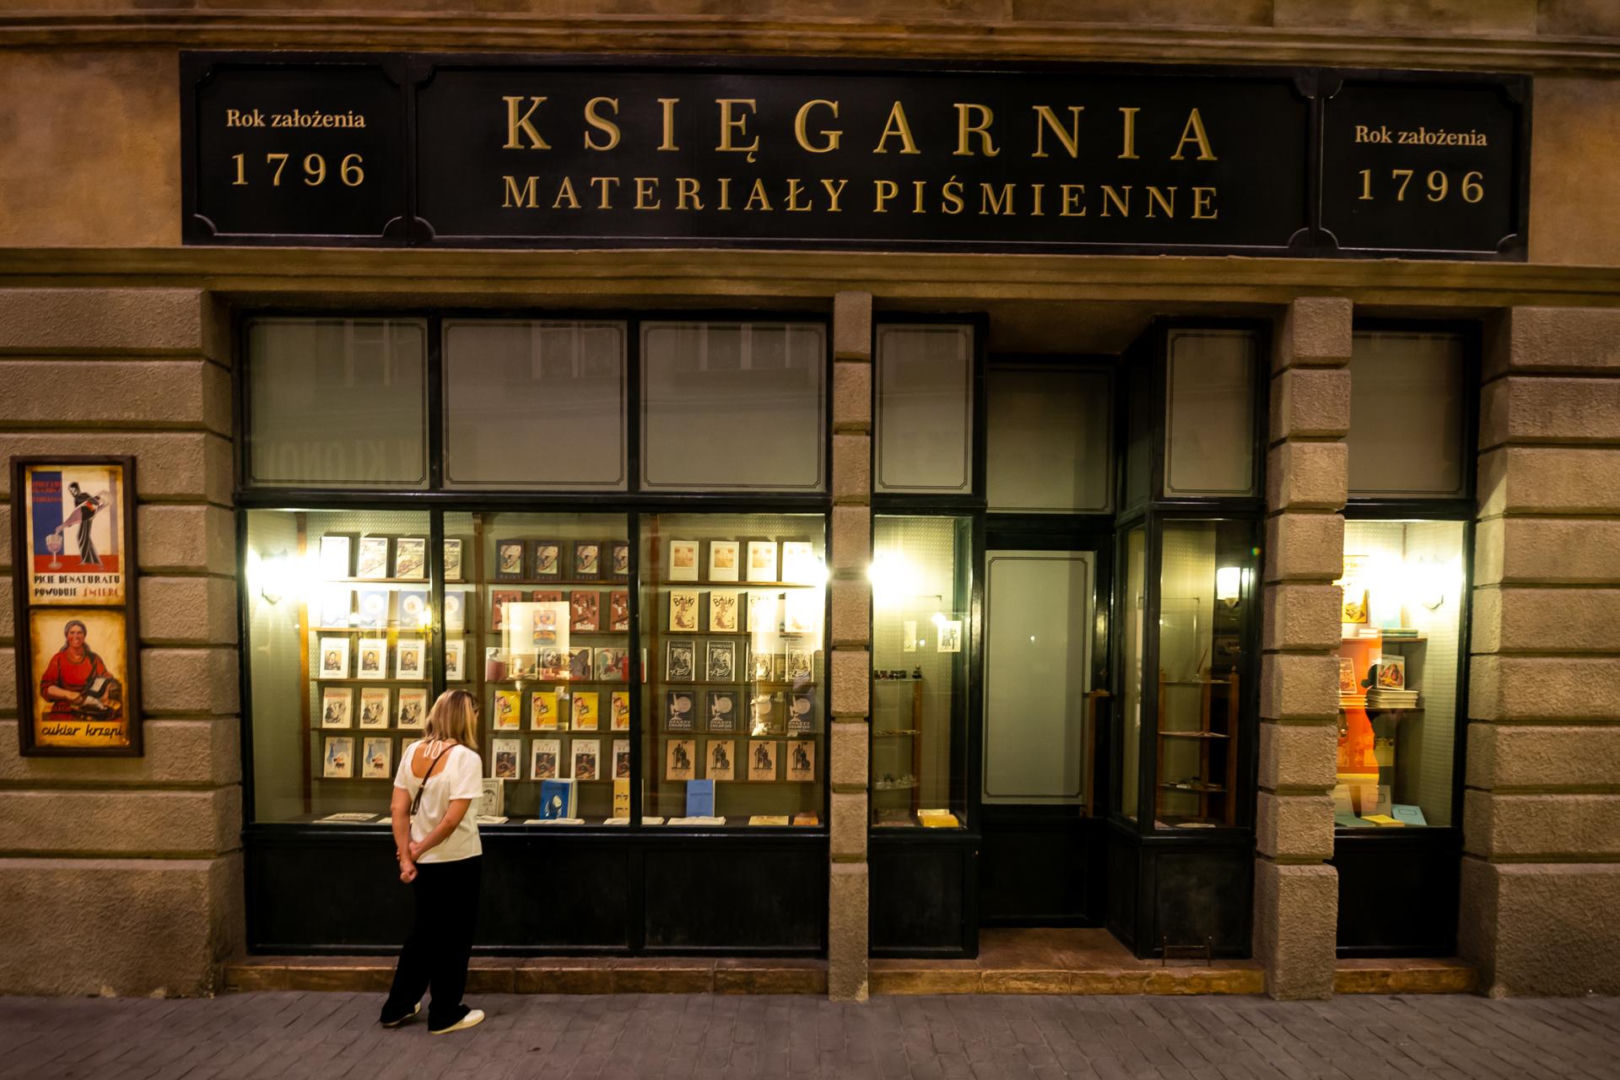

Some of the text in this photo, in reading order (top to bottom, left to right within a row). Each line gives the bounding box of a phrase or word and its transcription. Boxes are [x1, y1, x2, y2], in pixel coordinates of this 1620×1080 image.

[226, 109, 366, 128] Rok założenia
[502, 95, 1218, 164] KSIĘGARNIA
[1355, 125, 1487, 146] Rok założenia
[231, 152, 365, 187] 1796
[502, 174, 1219, 220] MATERIAŁY PIŚMIENNE
[1359, 169, 1484, 203] 1796
[58, 575, 120, 584] DENATURATU
[41, 723, 123, 739] cukier krzepi
